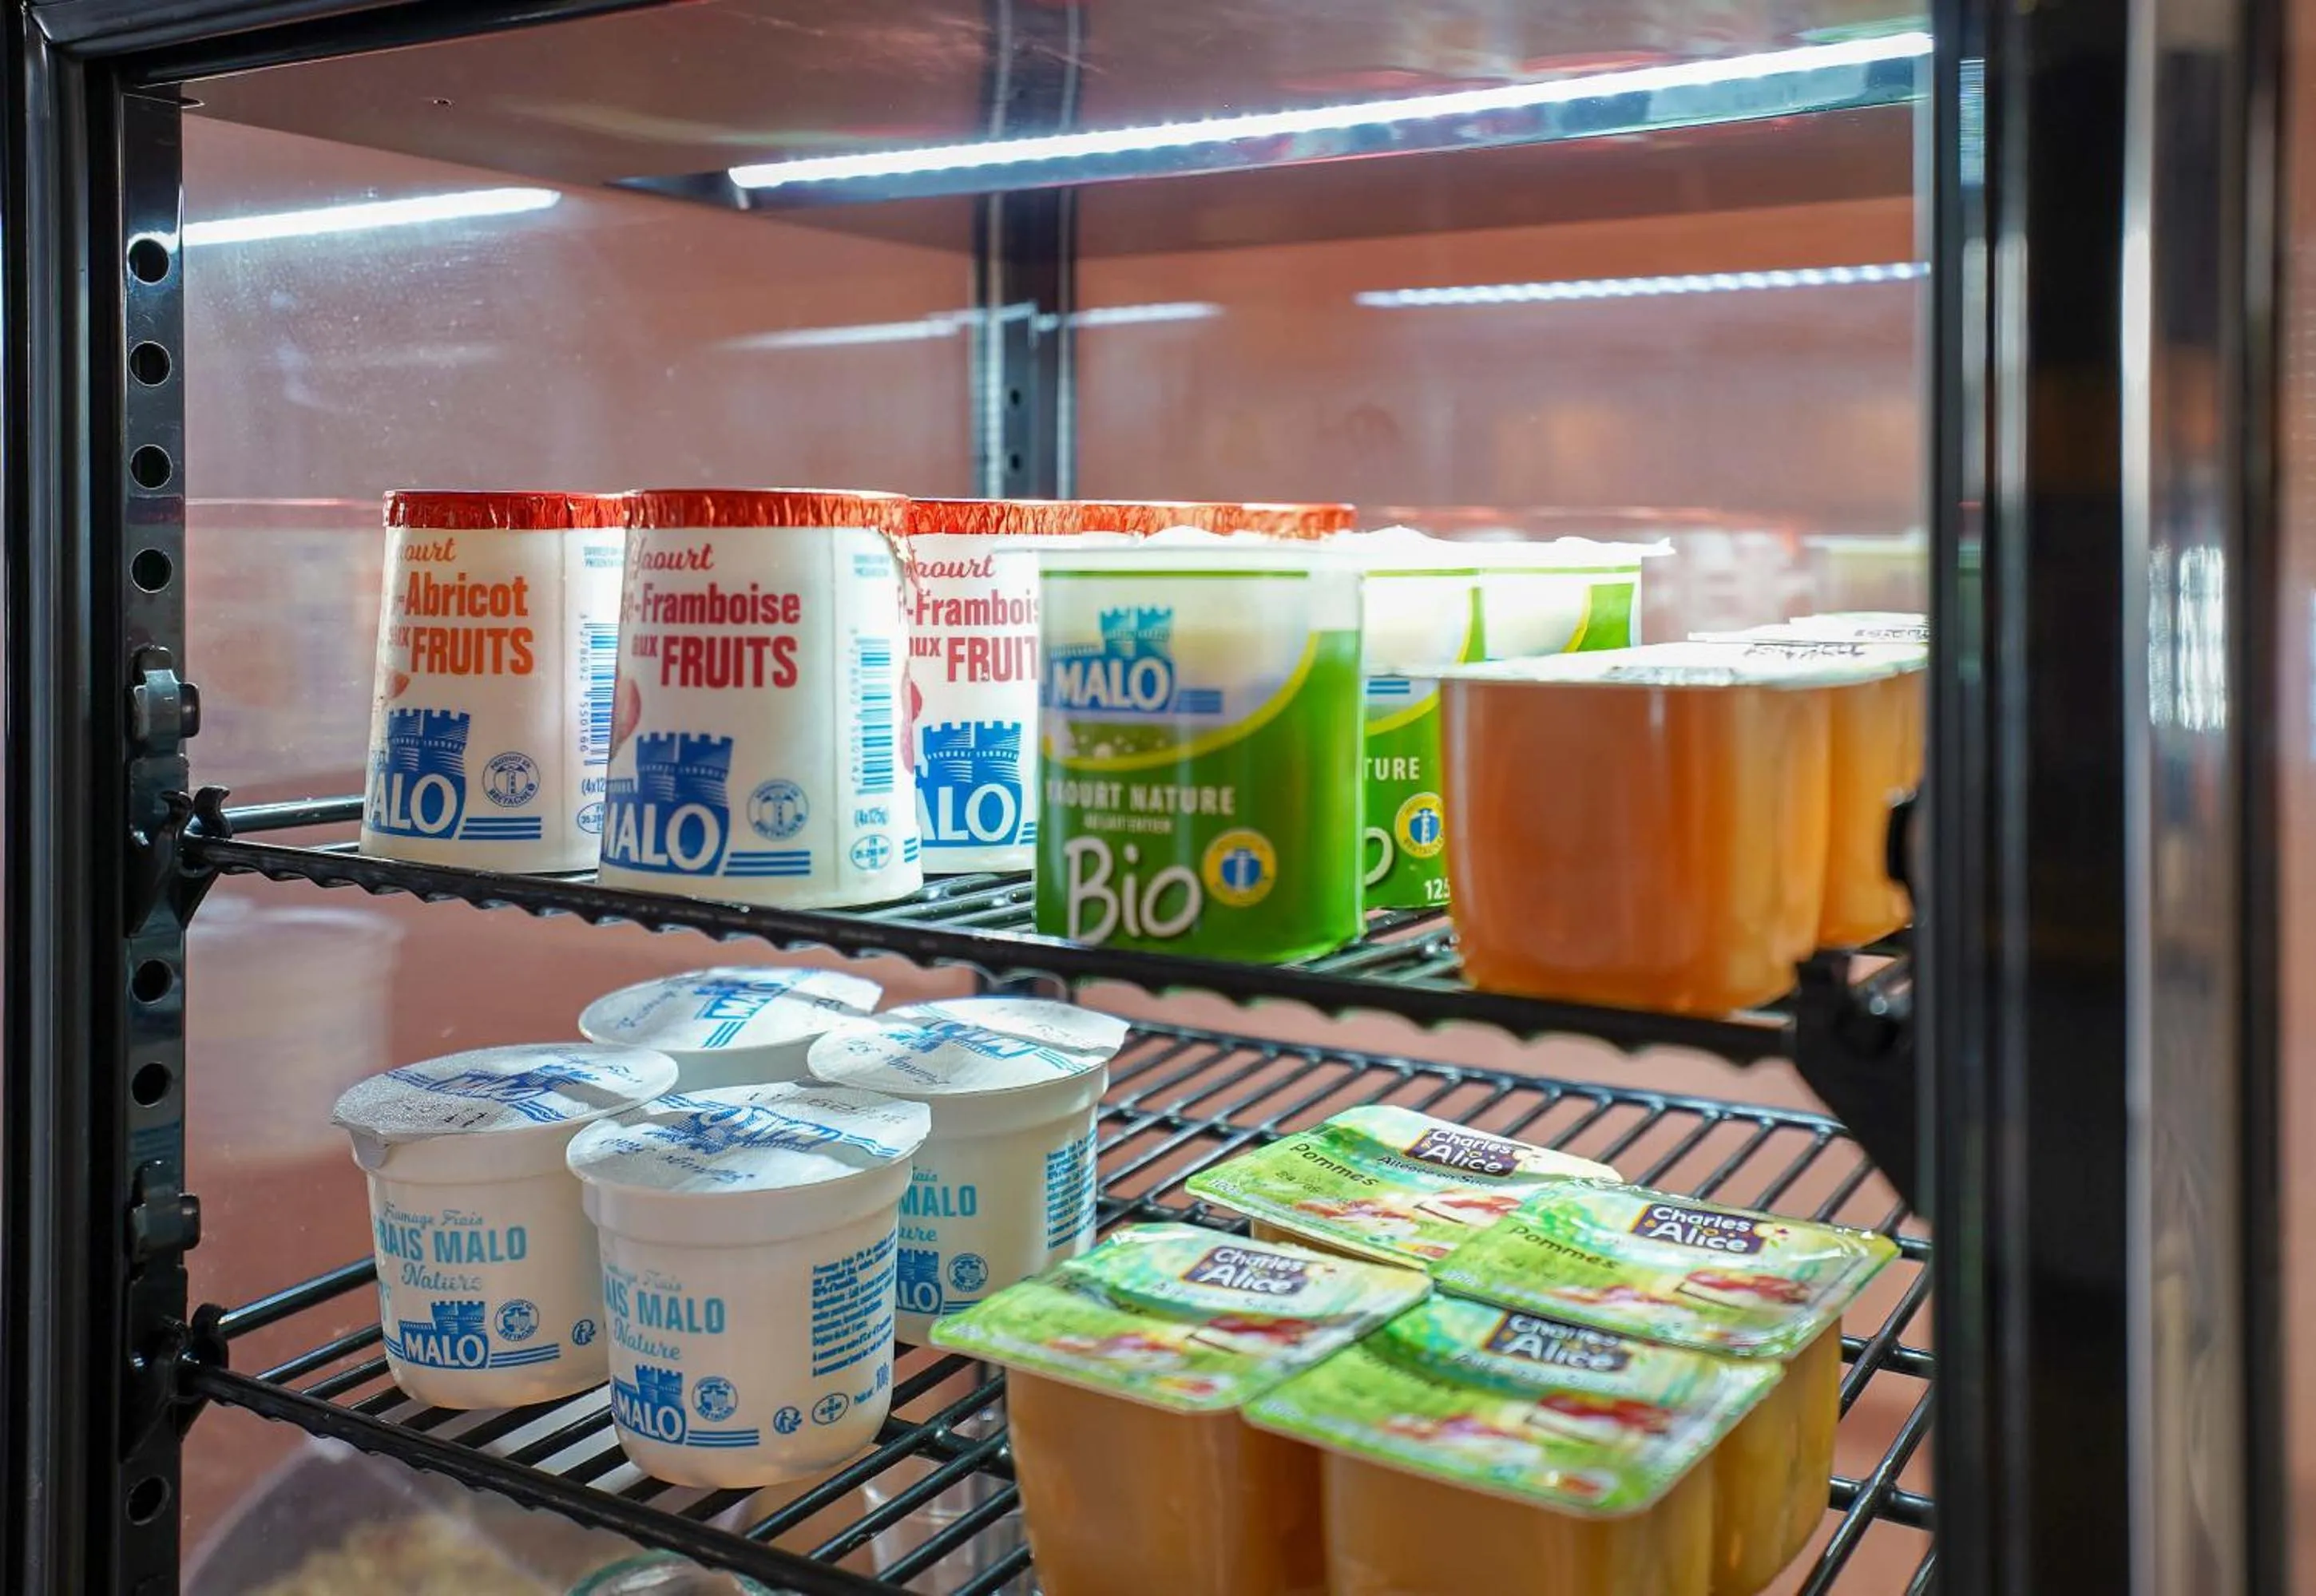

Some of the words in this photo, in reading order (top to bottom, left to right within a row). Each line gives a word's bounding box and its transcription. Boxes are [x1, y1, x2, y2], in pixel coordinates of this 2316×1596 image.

[399, 537, 456, 562] ourt
[395, 572, 529, 618] -Abricot
[410, 628, 534, 675] FRUITS
[662, 636, 798, 689] FRUITS
[947, 638, 1037, 683] FRUIT
[1052, 657, 1171, 711] MALO
[1364, 757, 1421, 781] TURE
[370, 772, 458, 834] ALO
[915, 783, 1017, 842] ALO
[1129, 783, 1236, 816] NATURE
[1063, 834, 1203, 947] Bio
[1421, 1144, 1505, 1173] Alice
[1431, 1130, 1513, 1154] Charles
[1289, 1143, 1380, 1187] Pommes
[376, 1215, 423, 1261] RAIS
[434, 1226, 527, 1264] MALO
[1648, 1222, 1749, 1253] Alice
[1652, 1206, 1751, 1233] Charles
[1199, 1264, 1293, 1294] Alice
[637, 1289, 725, 1335] MALO
[405, 1333, 485, 1367] MALO
[614, 1317, 682, 1360] Nature
[616, 1386, 683, 1442] MALO
